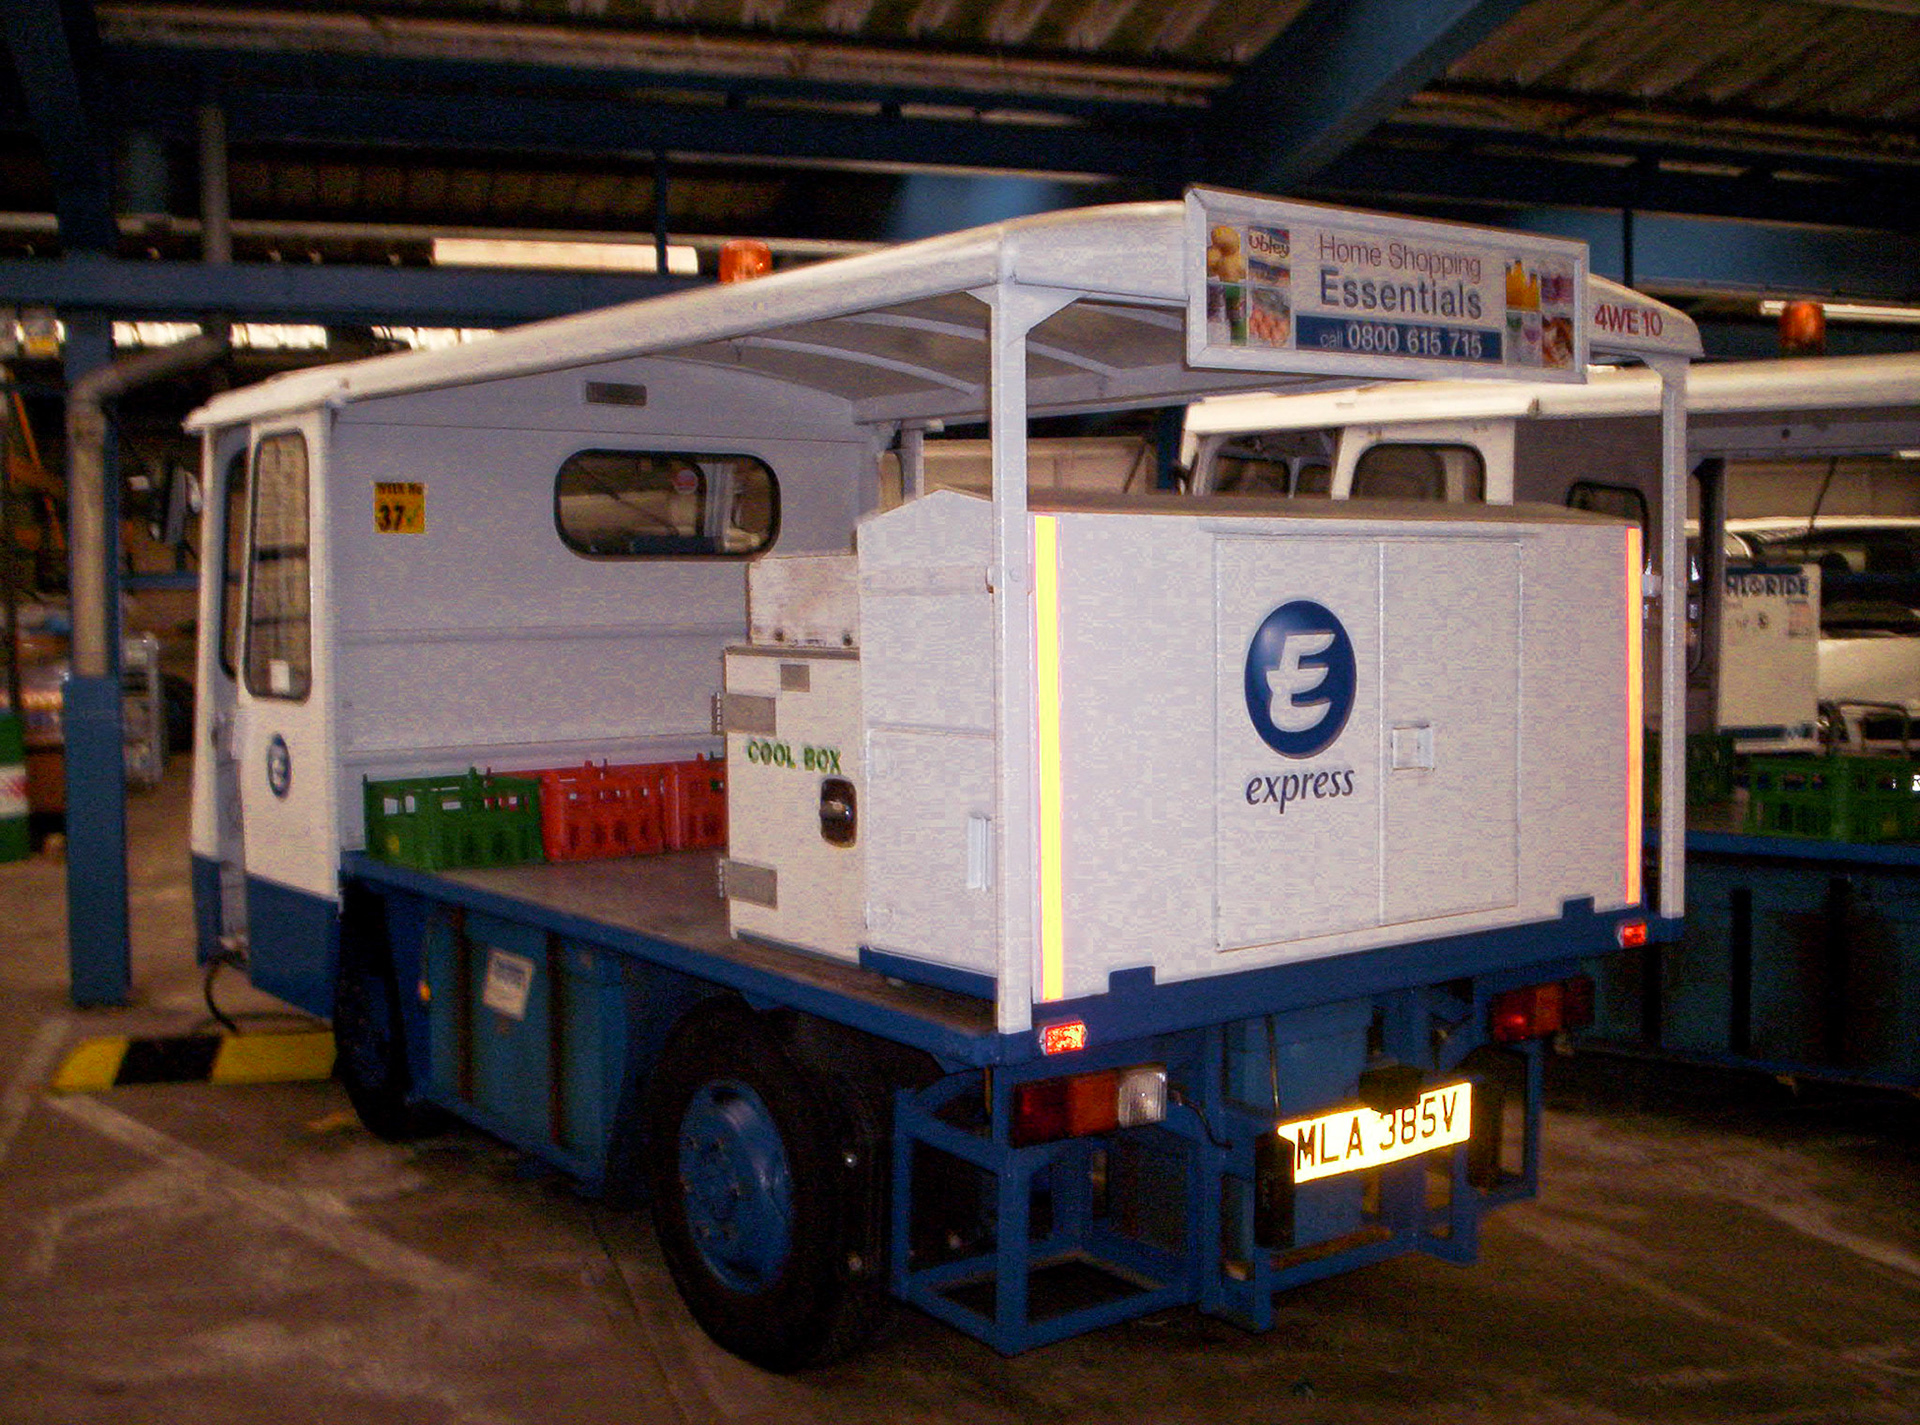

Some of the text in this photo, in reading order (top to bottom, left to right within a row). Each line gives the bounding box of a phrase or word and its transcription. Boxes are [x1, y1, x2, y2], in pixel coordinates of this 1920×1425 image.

[1319, 234, 1481, 285] Home Shopping
[1319, 268, 1482, 320] Essentials
[1320, 322, 1482, 360] call 0800 615 715
[378, 504, 406, 532] 37
[748, 740, 843, 775] COOL BOX
[1245, 768, 1355, 815] express
[1297, 1090, 1457, 1171] MLA 385V
